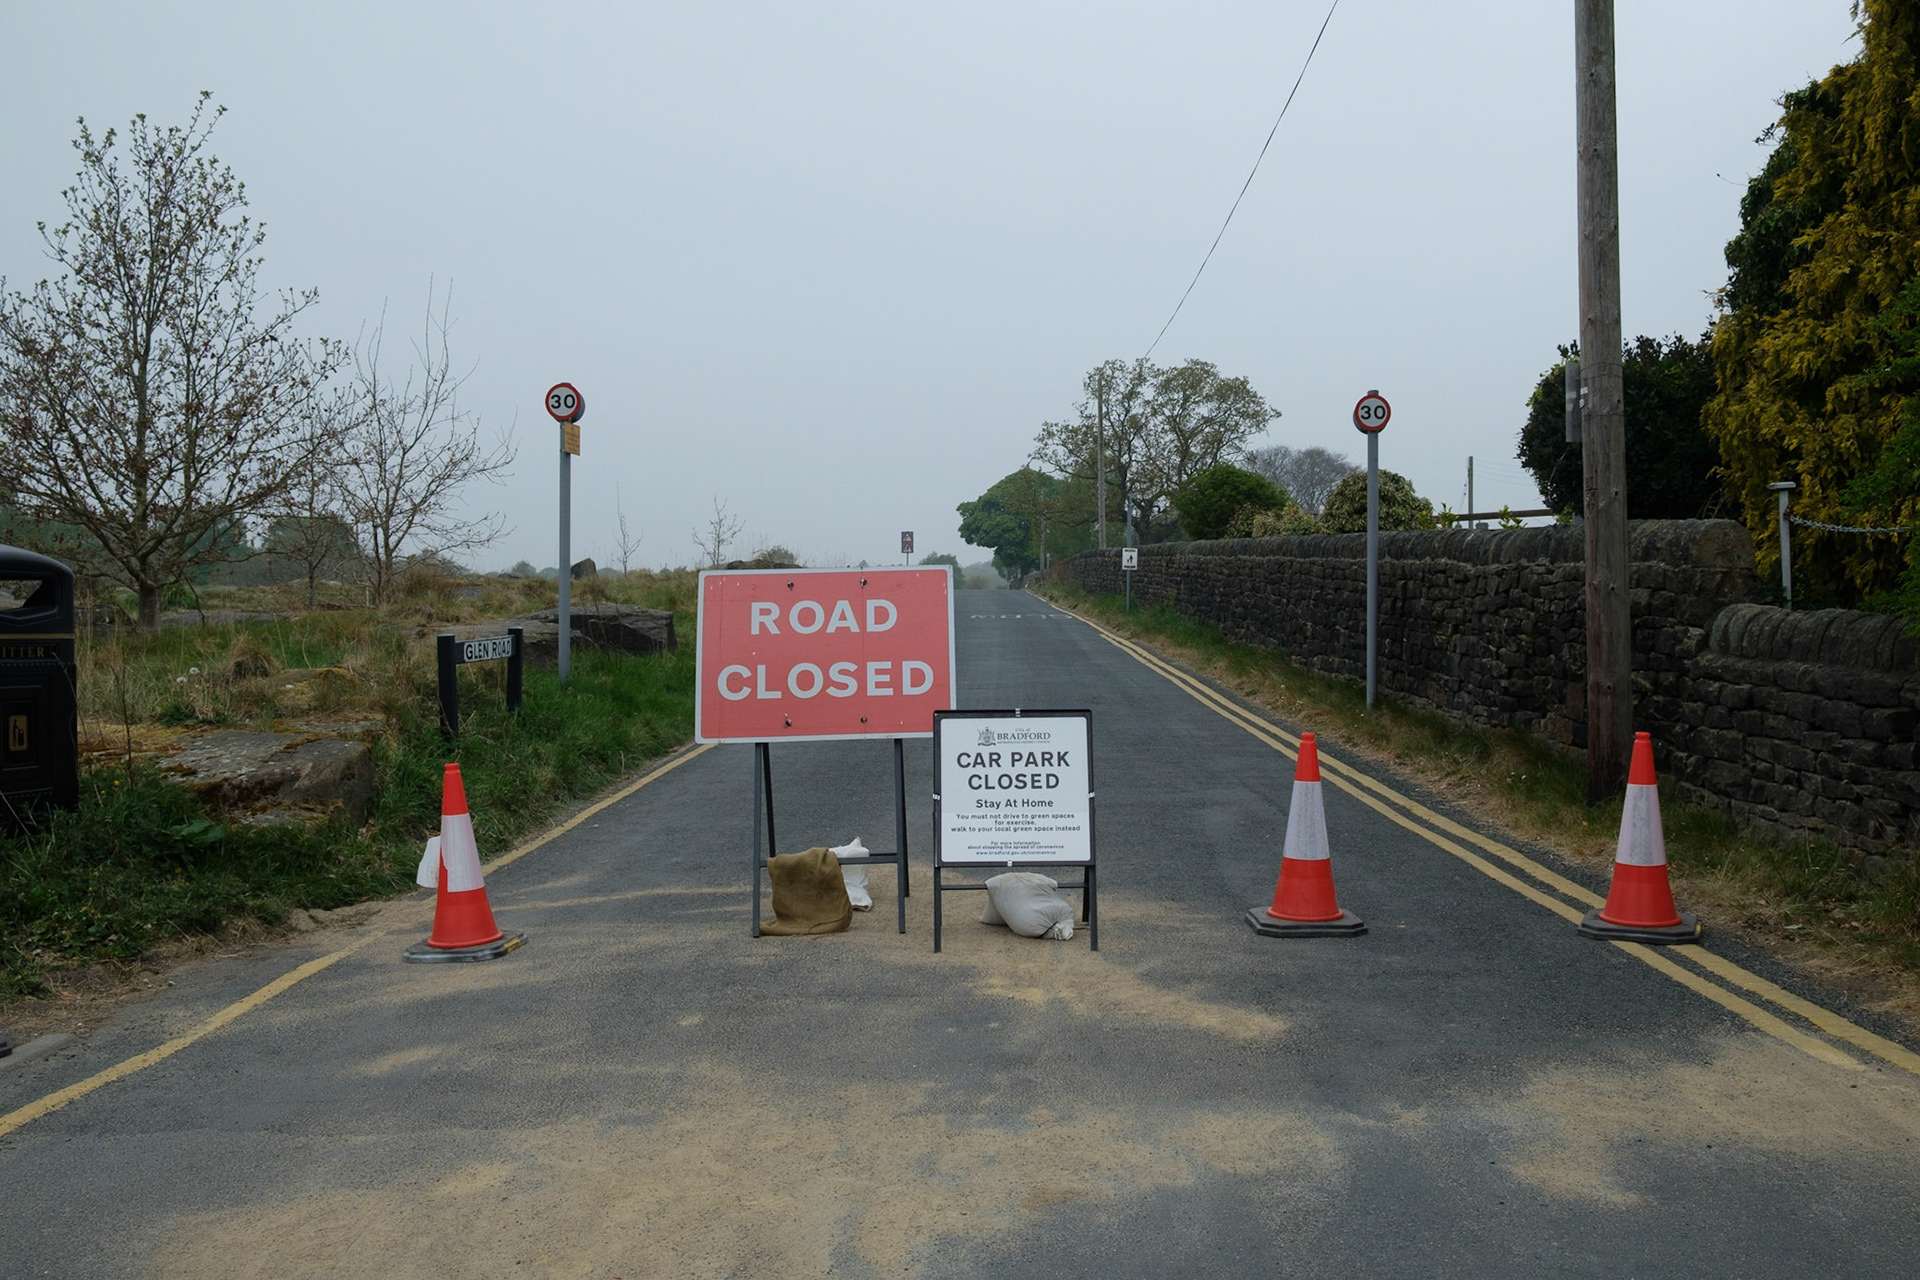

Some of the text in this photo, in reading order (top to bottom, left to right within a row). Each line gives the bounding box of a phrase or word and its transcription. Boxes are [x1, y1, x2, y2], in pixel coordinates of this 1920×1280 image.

[551, 394, 575, 409] 30
[1360, 405, 1386, 420] 30
[751, 599, 898, 635] ROAD
[1, 646, 45, 658] ITTER
[466, 640, 510, 660] GLEN ROAD
[717, 660, 934, 701] CLOSED
[997, 732, 1051, 740] BRADFORD
[957, 751, 1070, 768] CAR PARK
[968, 773, 1060, 790] CLOSED
[975, 799, 1054, 810] Stay At Home
